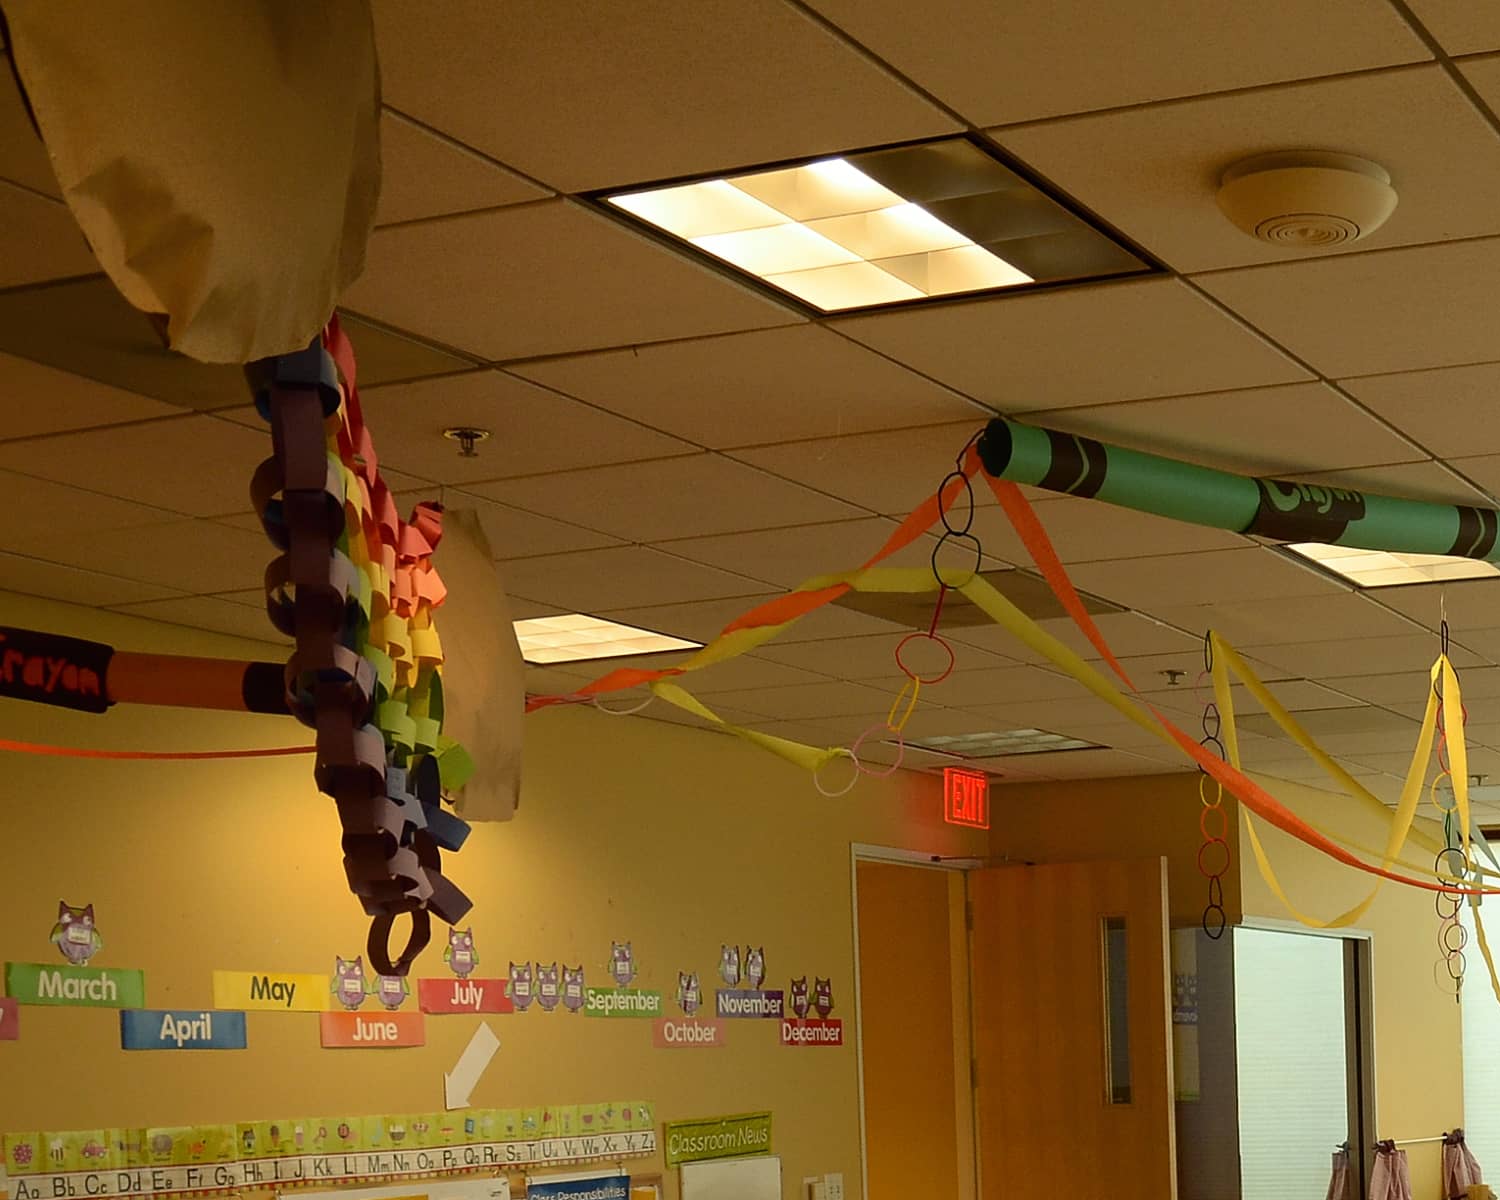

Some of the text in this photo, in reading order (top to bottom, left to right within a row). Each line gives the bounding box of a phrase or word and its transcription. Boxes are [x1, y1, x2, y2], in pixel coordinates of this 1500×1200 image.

[0, 634, 99, 696] rayon
[953, 774, 985, 822] EXIT
[38, 971, 116, 1001] March
[250, 976, 295, 1007] May
[450, 980, 484, 1010] July
[586, 989, 659, 1014] September
[718, 994, 782, 1014] November
[160, 1014, 212, 1047] April
[352, 1017, 398, 1041] June
[664, 1021, 716, 1042] October
[782, 1022, 840, 1042] December
[669, 1122, 768, 1154] Classroom News
